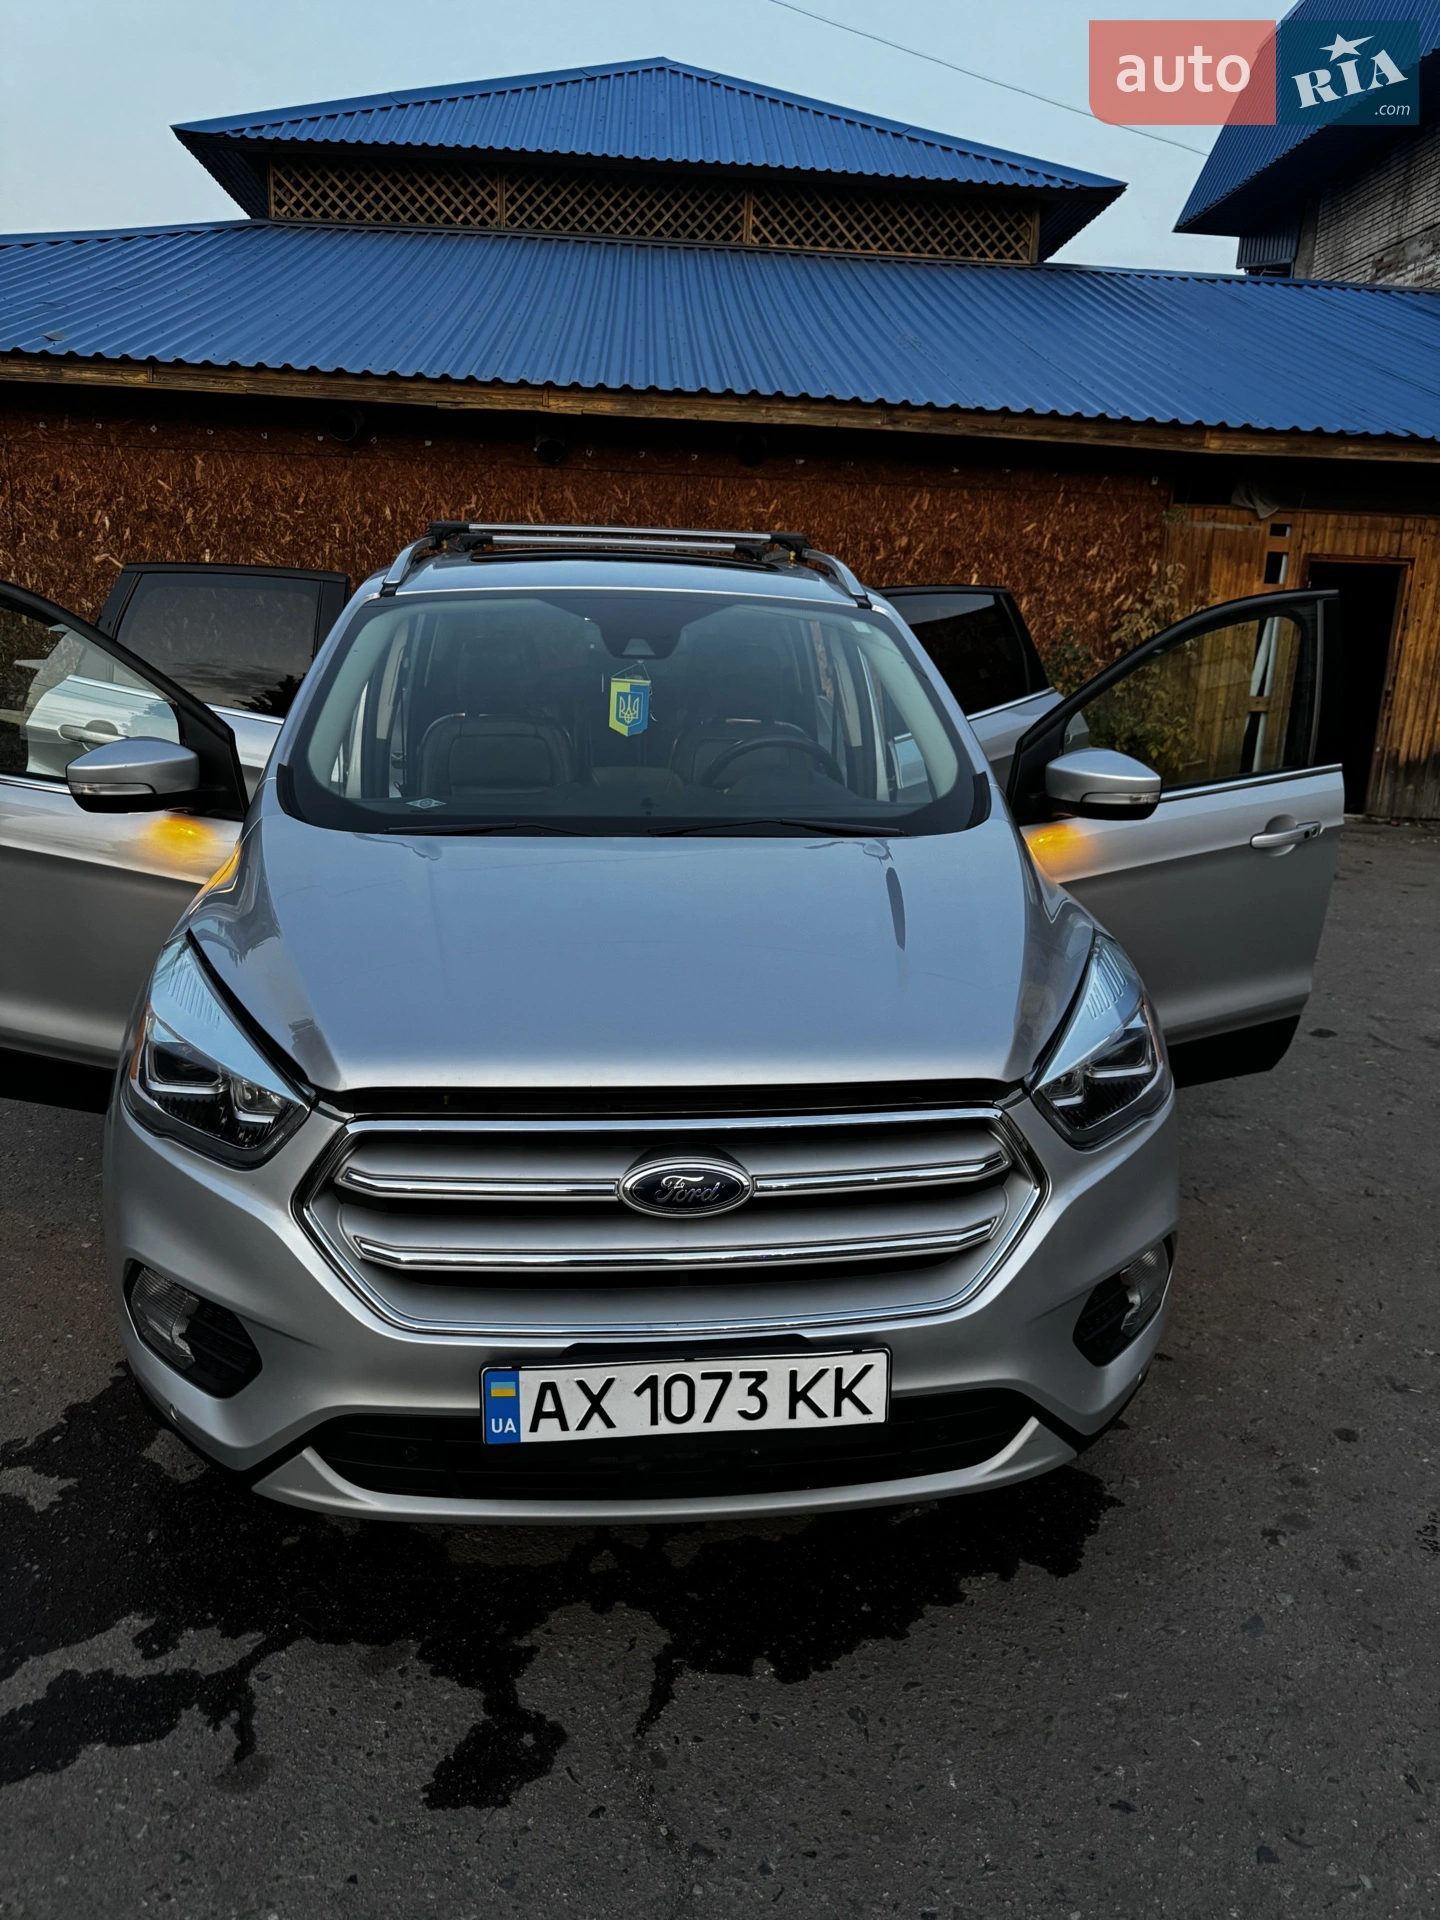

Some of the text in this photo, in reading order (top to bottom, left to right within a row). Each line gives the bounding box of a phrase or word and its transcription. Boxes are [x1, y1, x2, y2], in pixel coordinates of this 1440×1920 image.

[655, 1175, 720, 1203] Ford
[529, 1363, 874, 1433] AX 1073 KK
[491, 1418, 516, 1433] UA
